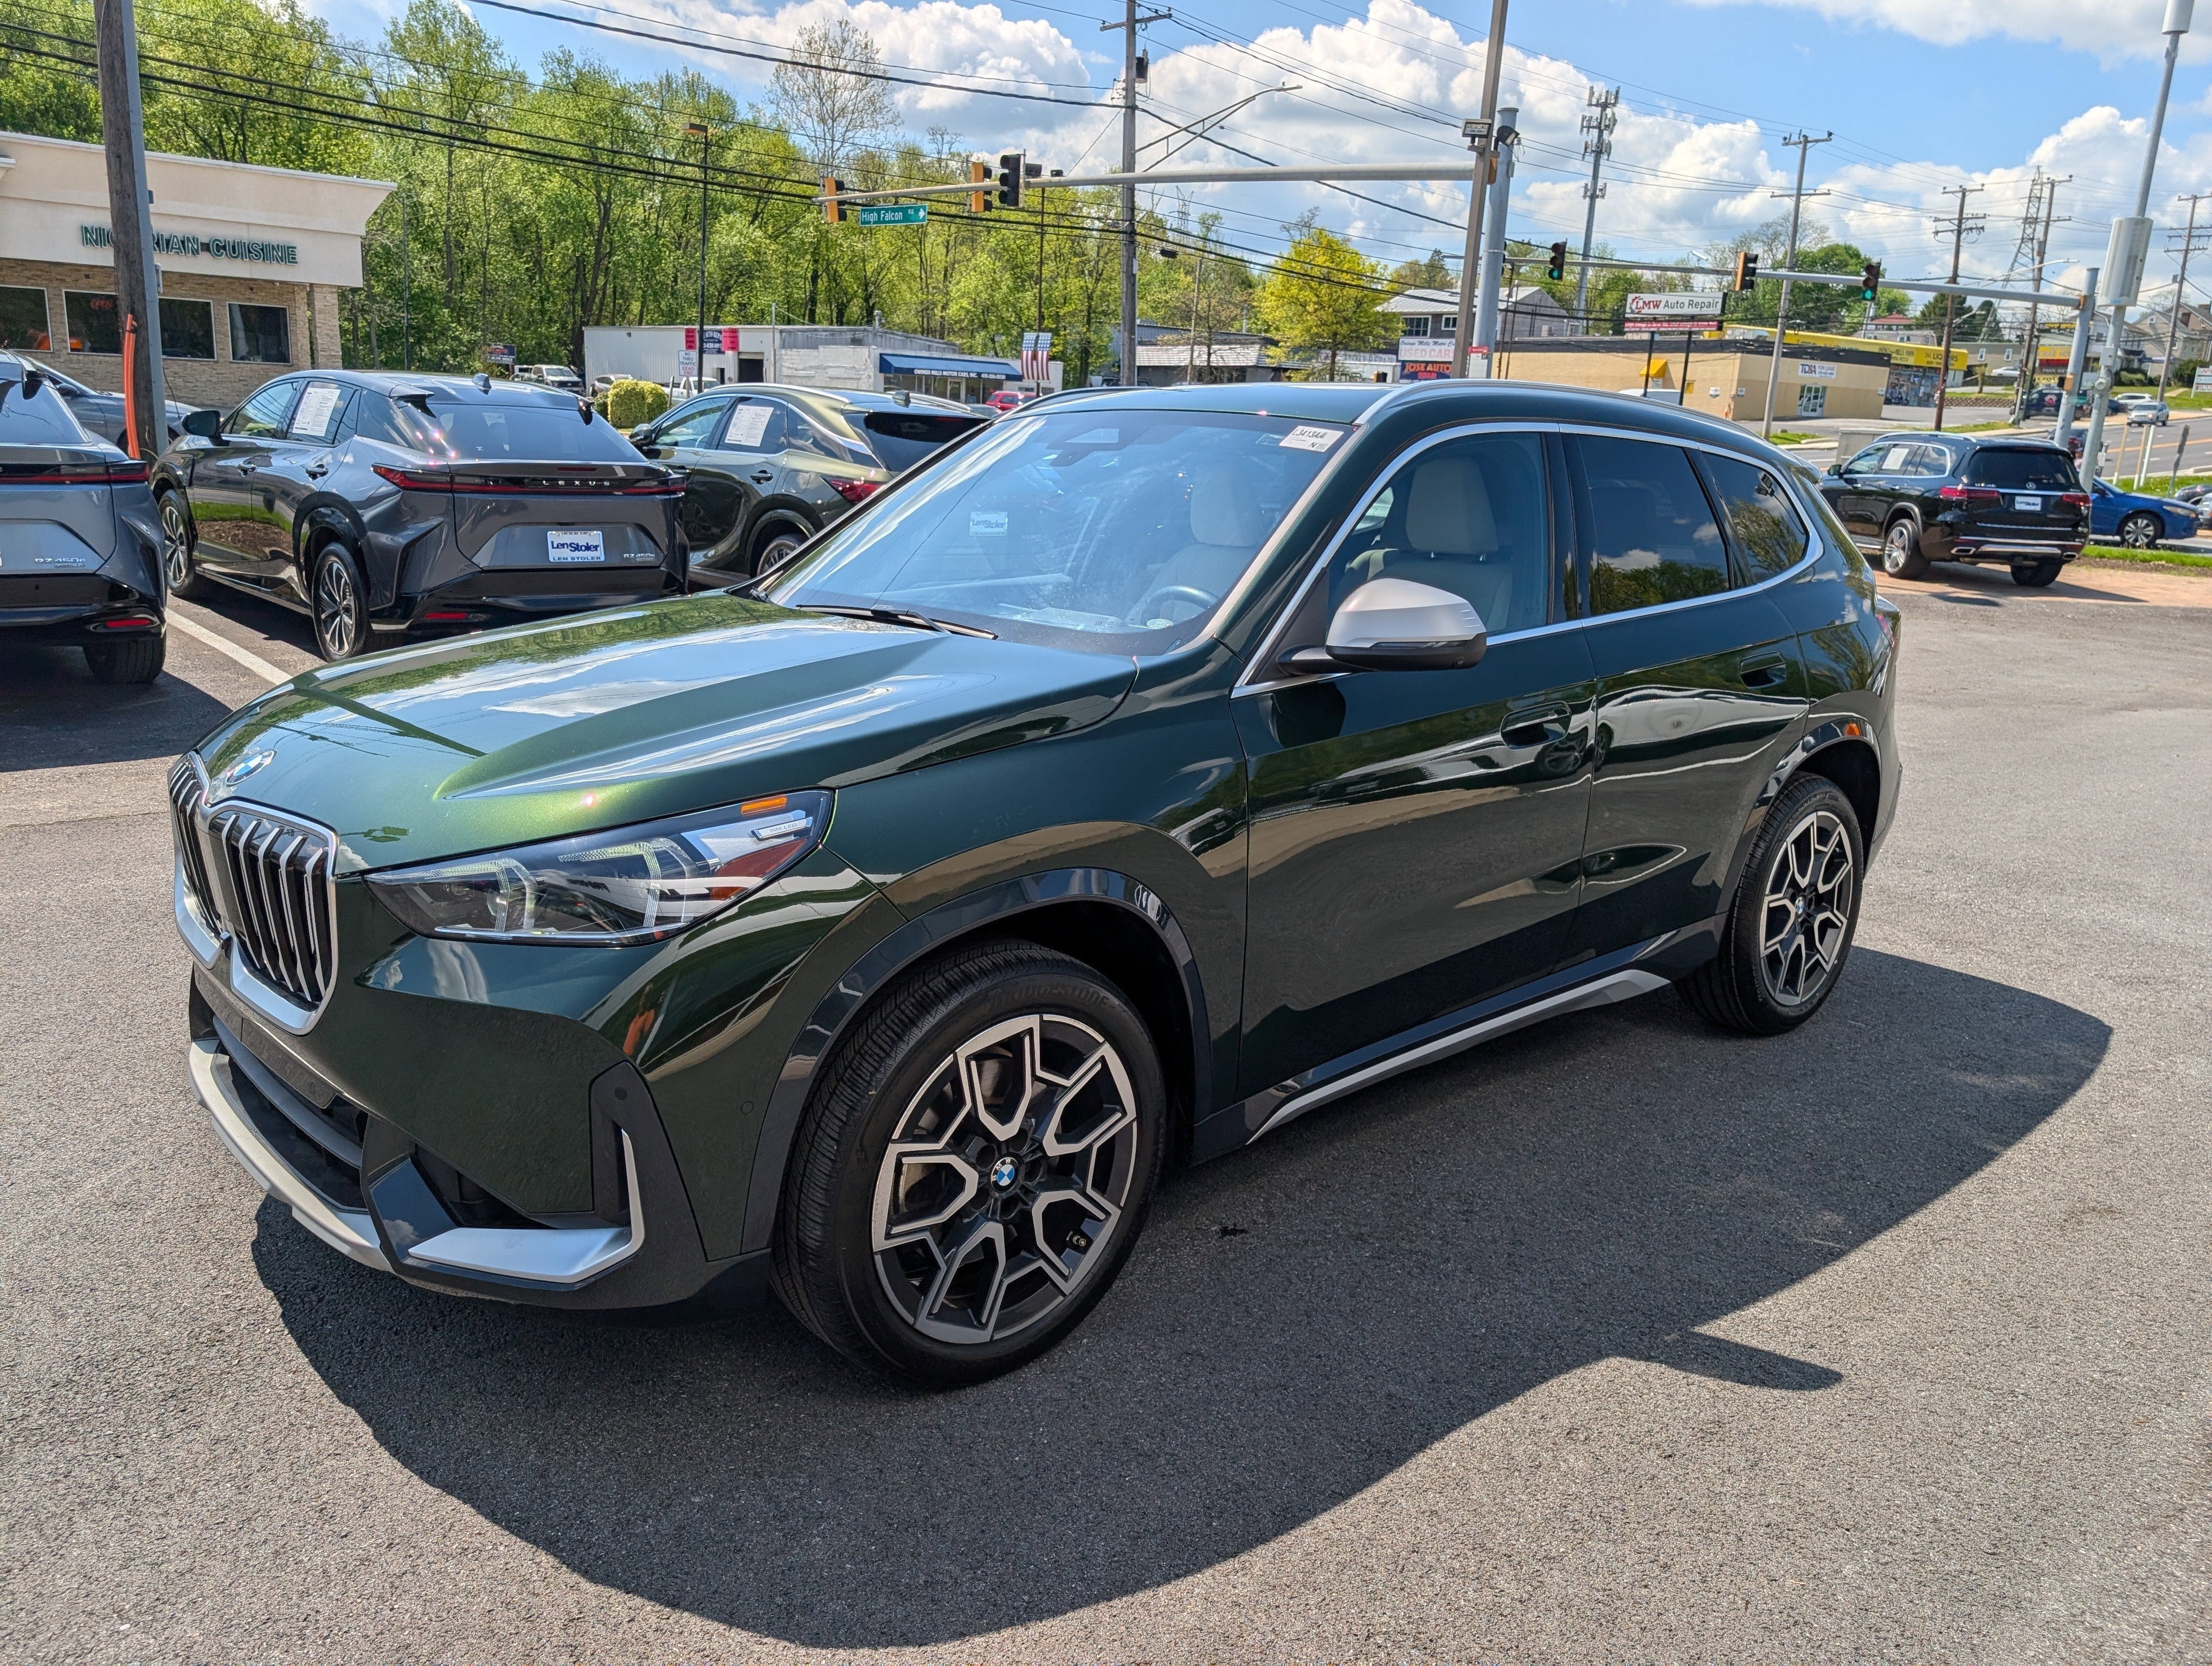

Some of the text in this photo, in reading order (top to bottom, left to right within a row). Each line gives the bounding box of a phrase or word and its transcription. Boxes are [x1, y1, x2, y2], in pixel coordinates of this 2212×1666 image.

[861, 211, 878, 224] High
[880, 210, 903, 221] Falcon
[82, 225, 299, 266] NIRIAN CUISINE
[1635, 299, 1719, 311] LMW Auto Repair
[1400, 348, 1427, 358] USED
[1404, 363, 1451, 373] JOSE AUTO
[992, 1158, 1012, 1182] BMW
